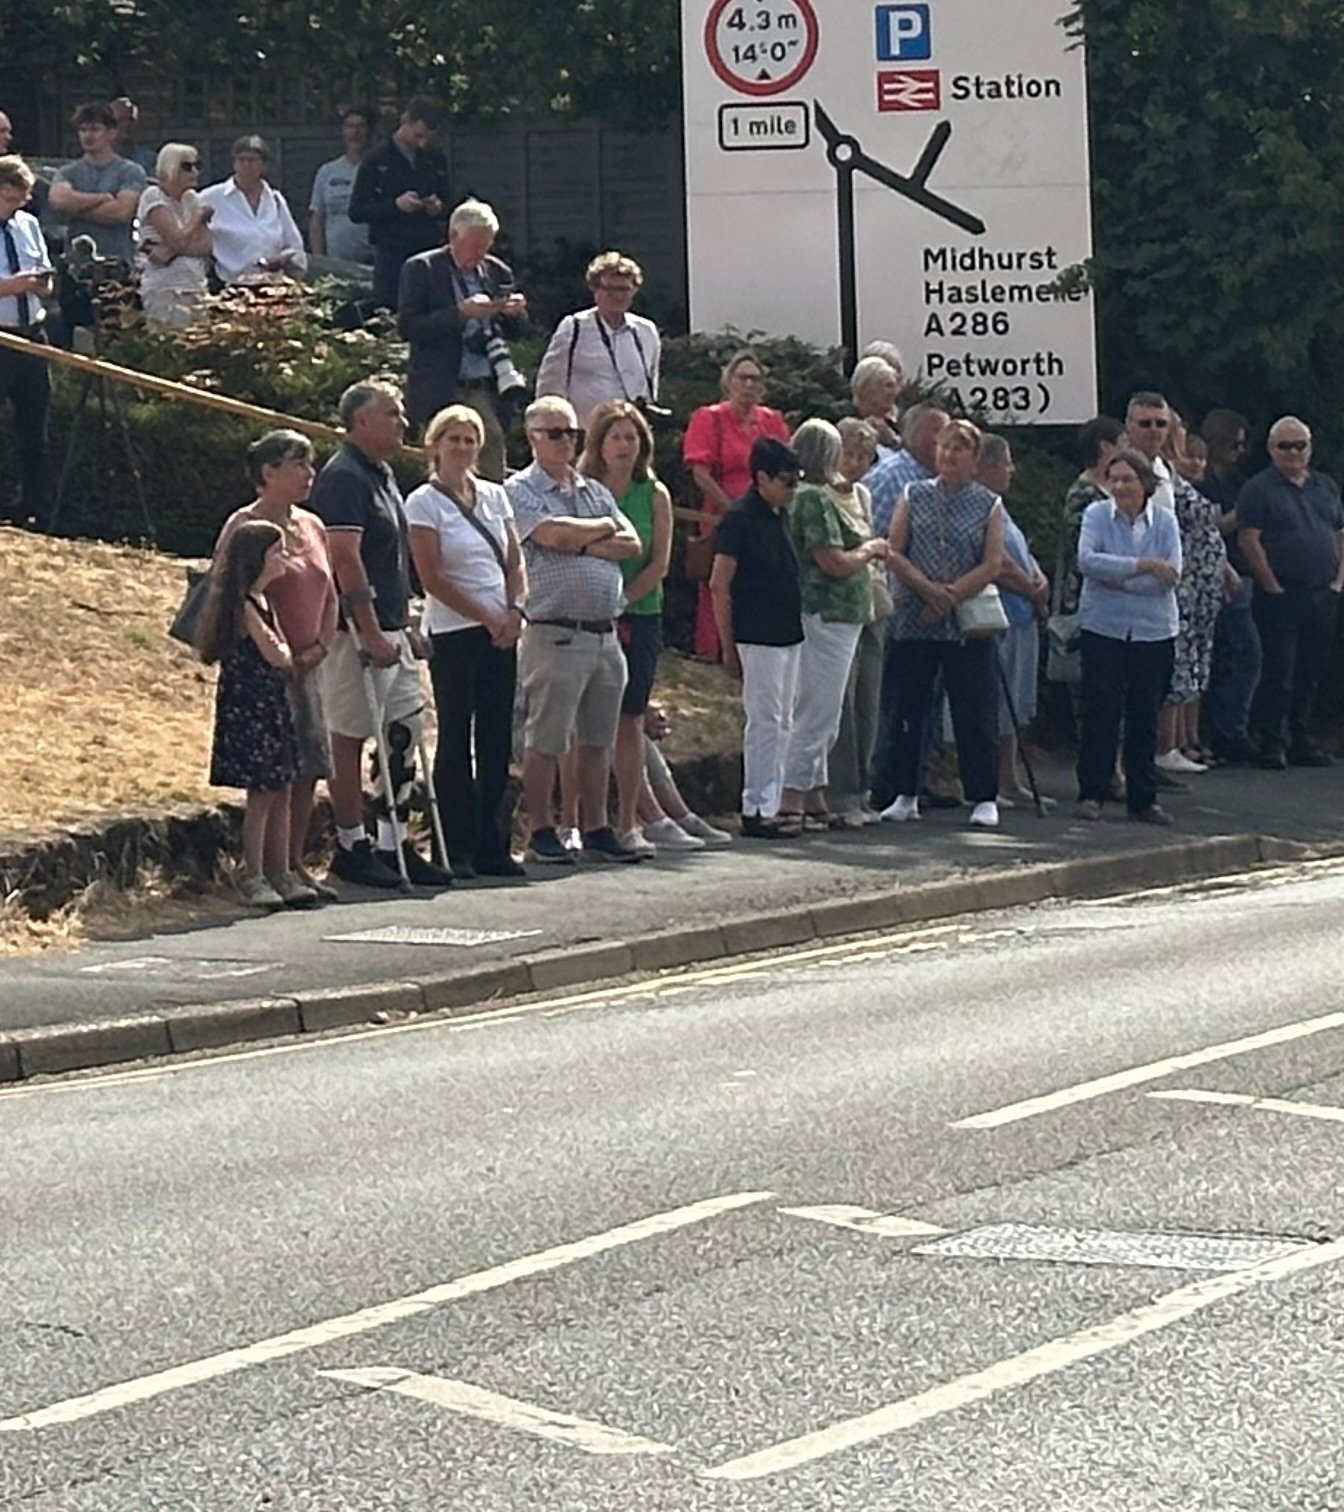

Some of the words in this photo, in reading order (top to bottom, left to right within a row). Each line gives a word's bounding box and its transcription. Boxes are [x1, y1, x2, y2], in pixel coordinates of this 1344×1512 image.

[726, 7, 771, 32] 4.3
[778, 12, 798, 29] m
[888, 9, 922, 56] P
[950, 73, 1062, 101] Station
[731, 117, 740, 137] 1
[749, 115, 797, 136] mile
[923, 245, 1059, 272] Midhurst
[923, 310, 1010, 338] A286
[926, 351, 1064, 378] Petworth
